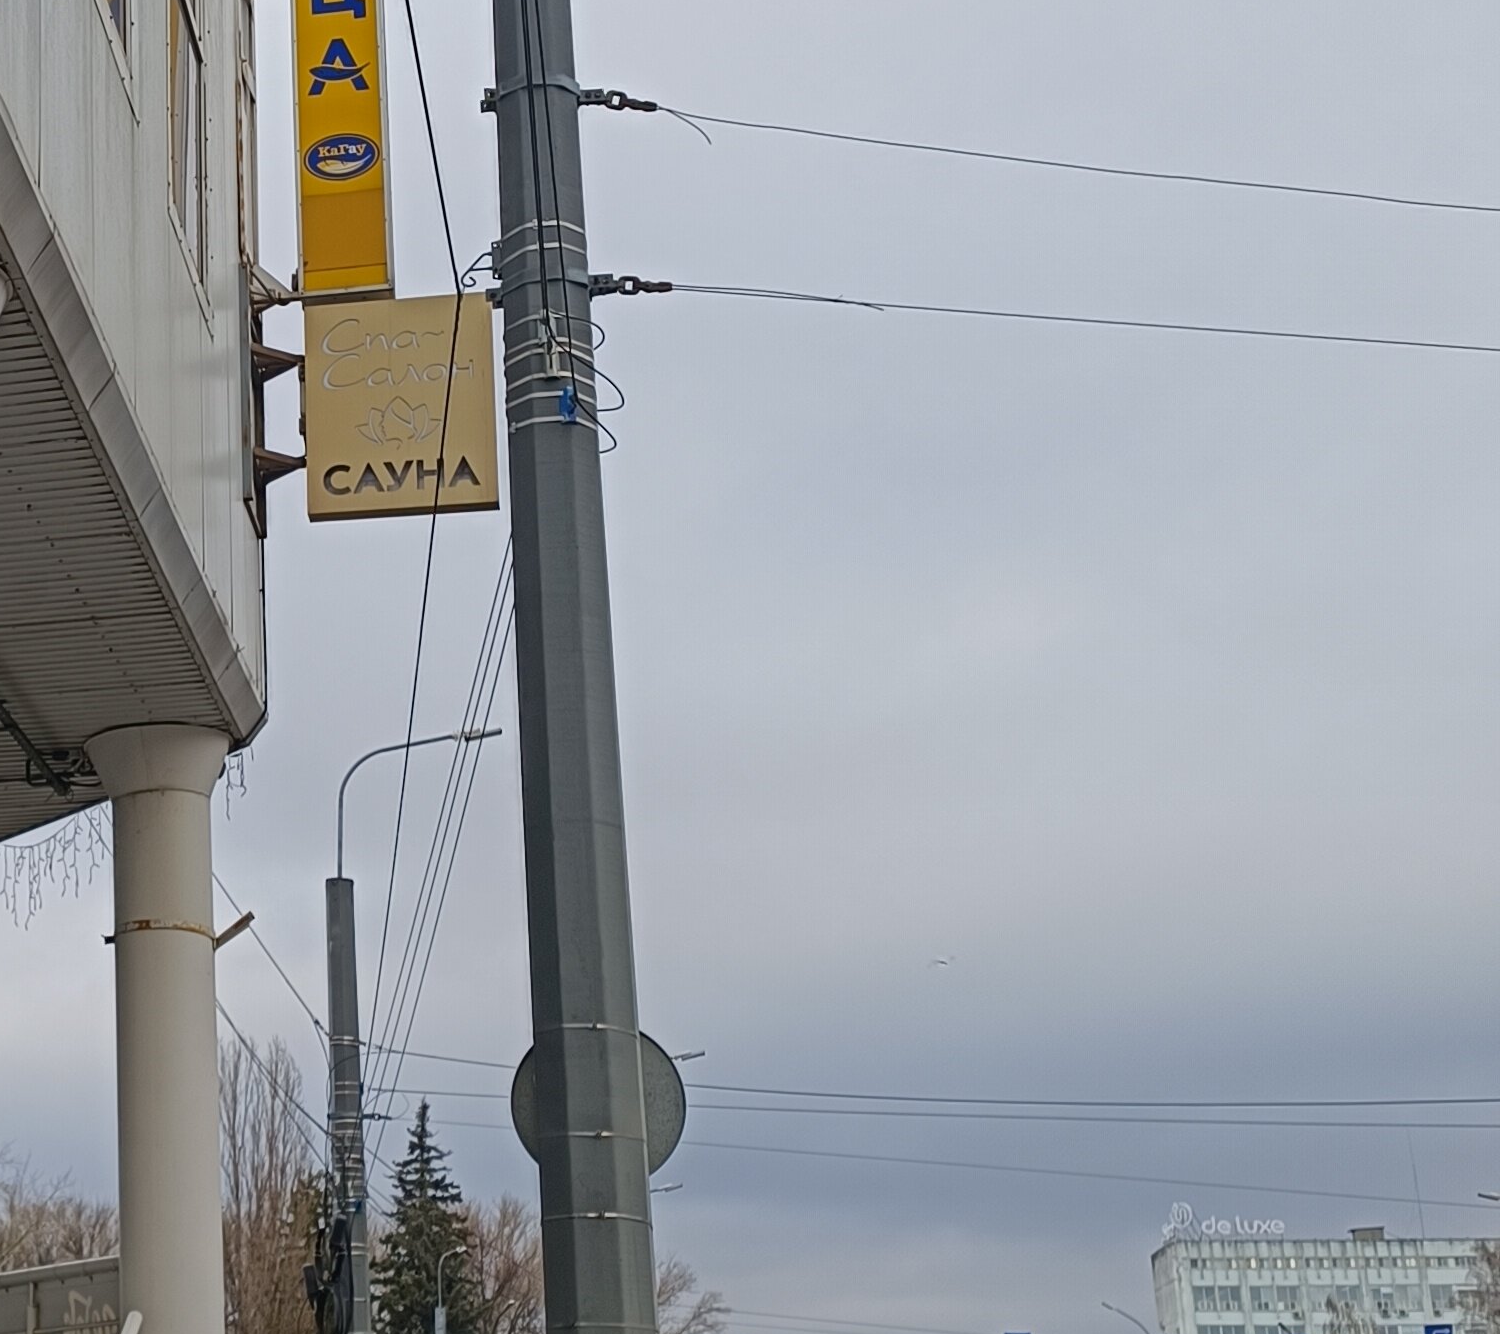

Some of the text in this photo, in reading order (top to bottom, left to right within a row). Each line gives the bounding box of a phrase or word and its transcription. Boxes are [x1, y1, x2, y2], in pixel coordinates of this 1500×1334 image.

[323, 353, 475, 390] Салон
[323, 454, 481, 496] САУНА
[1201, 1214, 1285, 1235] de luxe
